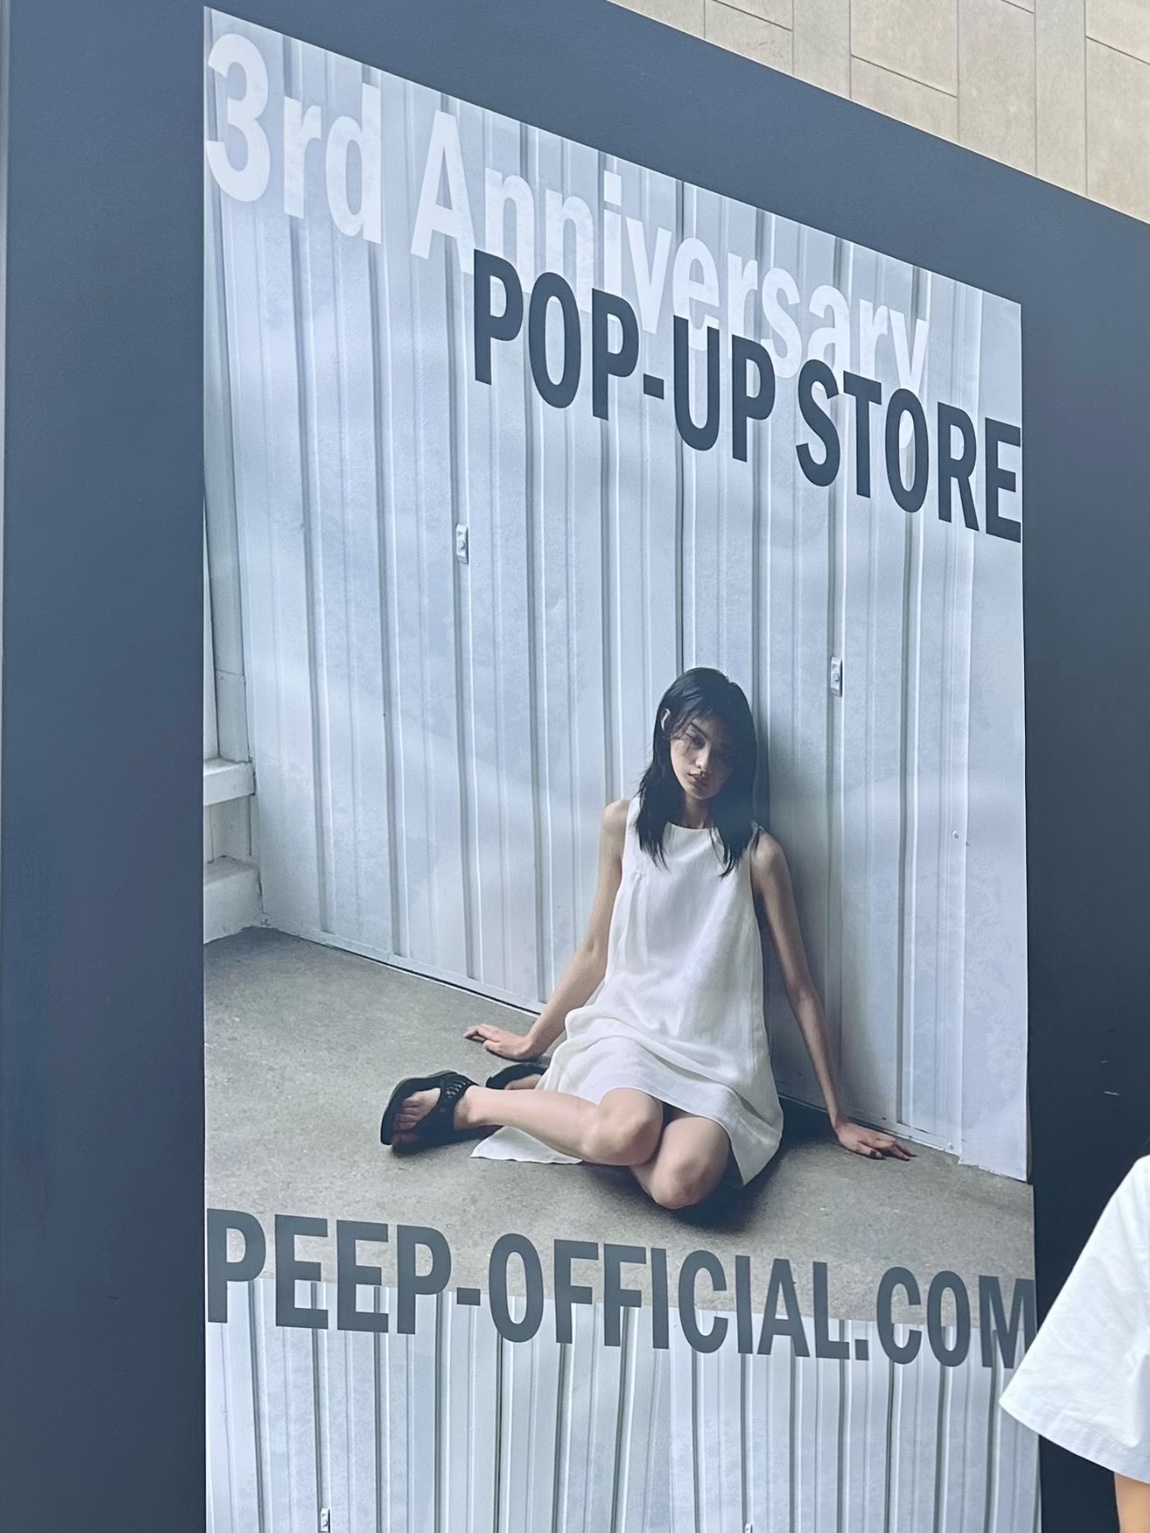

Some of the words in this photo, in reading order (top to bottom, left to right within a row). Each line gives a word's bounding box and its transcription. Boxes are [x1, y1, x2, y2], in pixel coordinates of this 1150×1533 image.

[205, 33, 382, 245] 3rd
[409, 109, 930, 450] Anniversary
[473, 248, 776, 463] POP-UP
[795, 358, 1022, 544] STORE
[206, 1207, 1038, 1369] PEEP-OFFICIAL.COM
